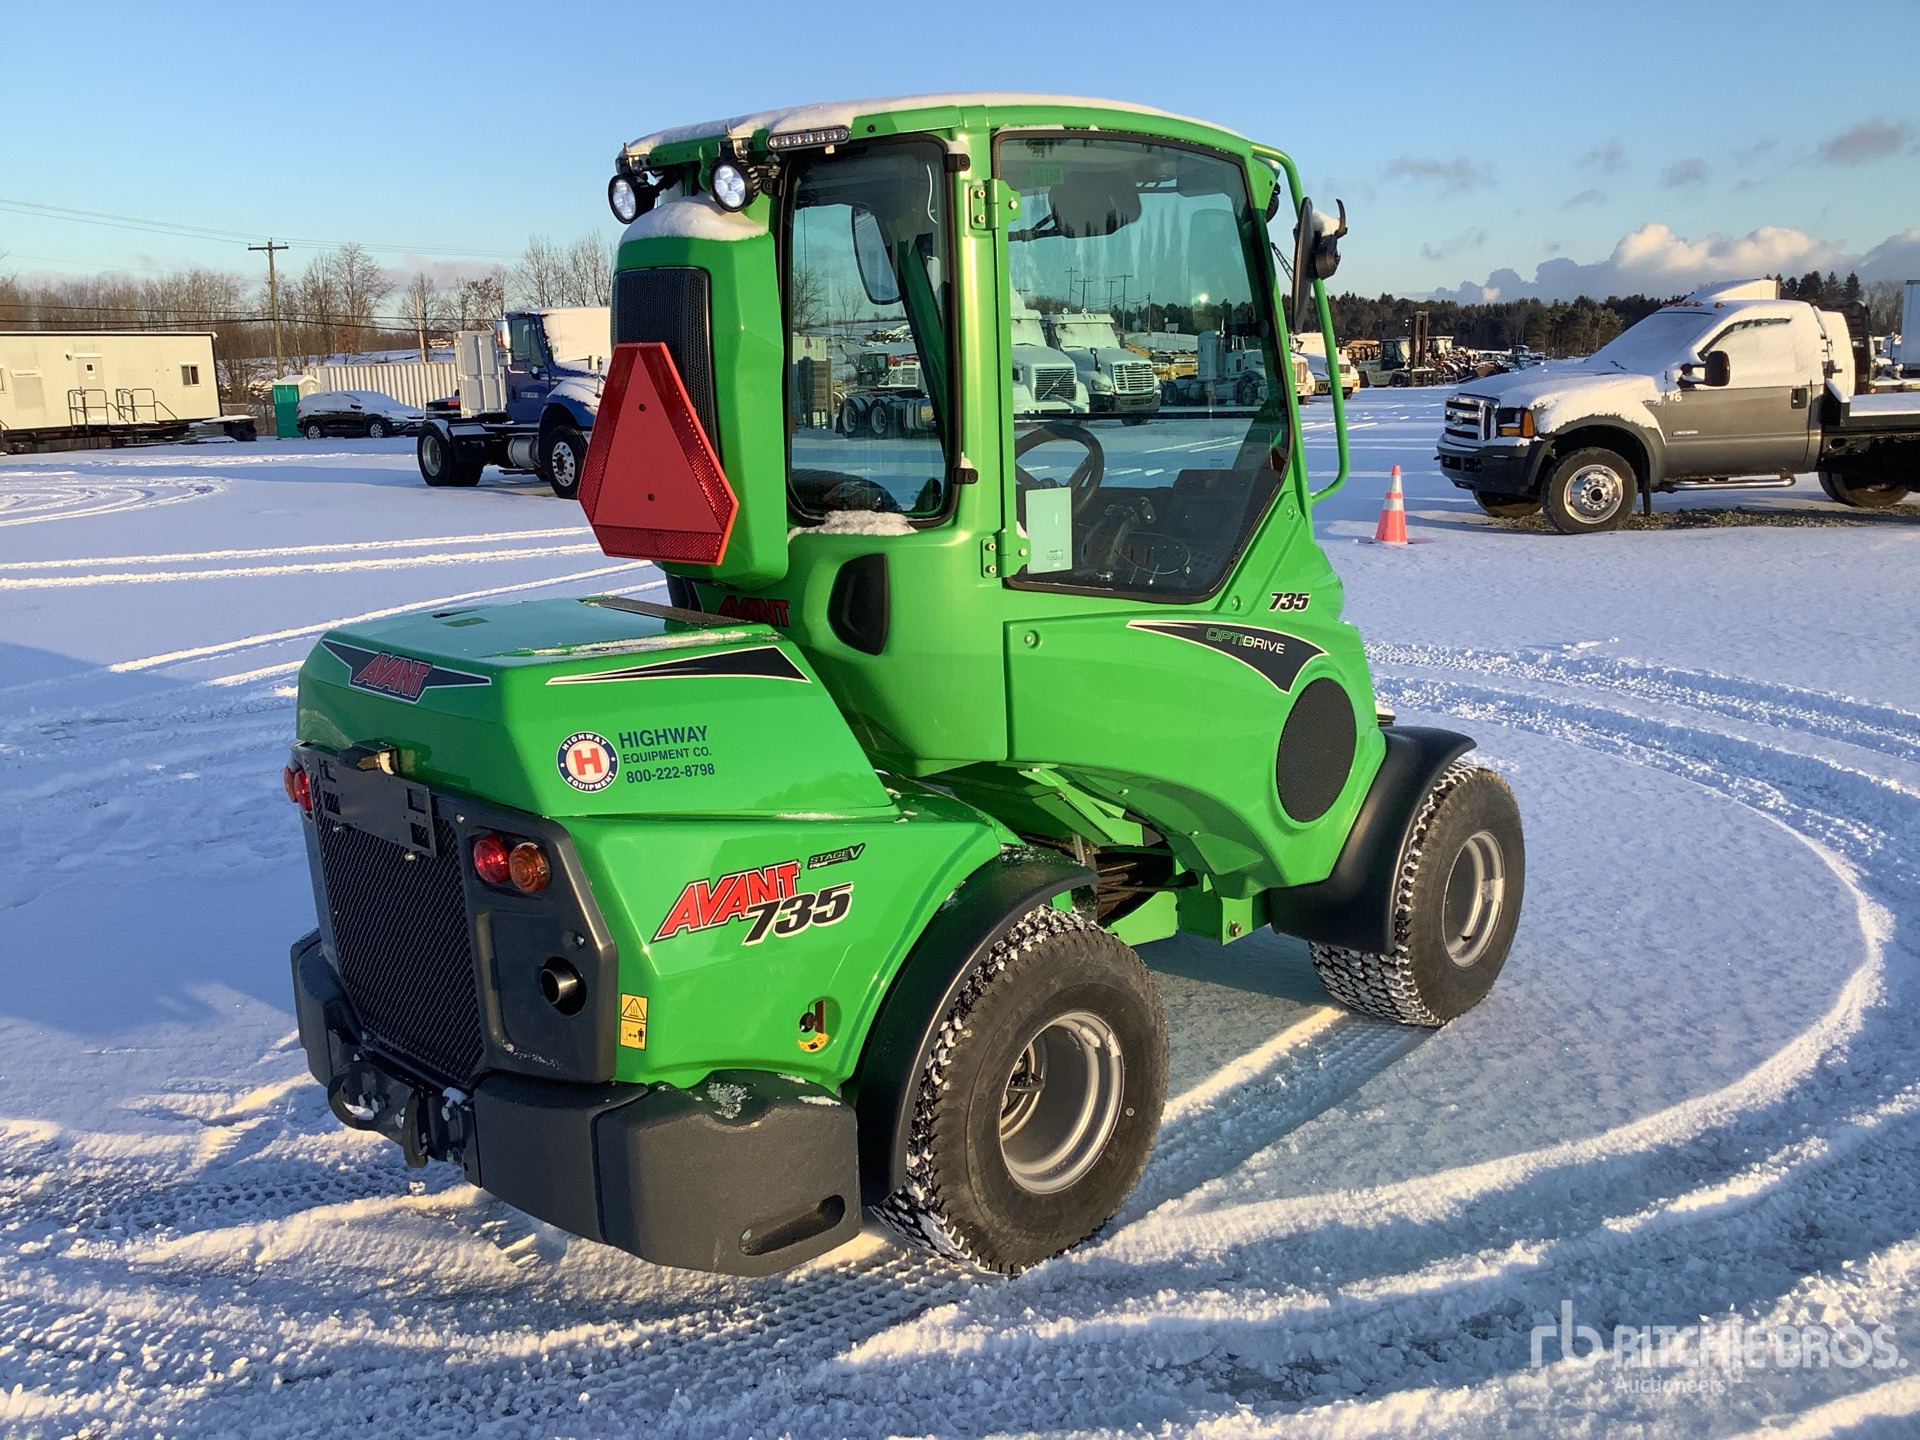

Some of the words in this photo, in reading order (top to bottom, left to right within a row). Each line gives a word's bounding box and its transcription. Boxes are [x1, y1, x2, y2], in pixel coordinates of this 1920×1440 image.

[717, 594, 790, 628] AVANT
[1268, 592, 1311, 612] 735
[1206, 628, 1285, 654] OPTIDRIVE
[353, 652, 433, 699] AVANT
[562, 733, 607, 751] HIGHWAY
[618, 725, 708, 749] HIGHWAY
[573, 748, 603, 776] H
[622, 748, 690, 765] EQUIPMENT
[692, 746, 712, 758] CO.
[566, 770, 616, 791] EQUIPMENT
[626, 763, 715, 784] 800-222-8798
[742, 882, 854, 946] 735
